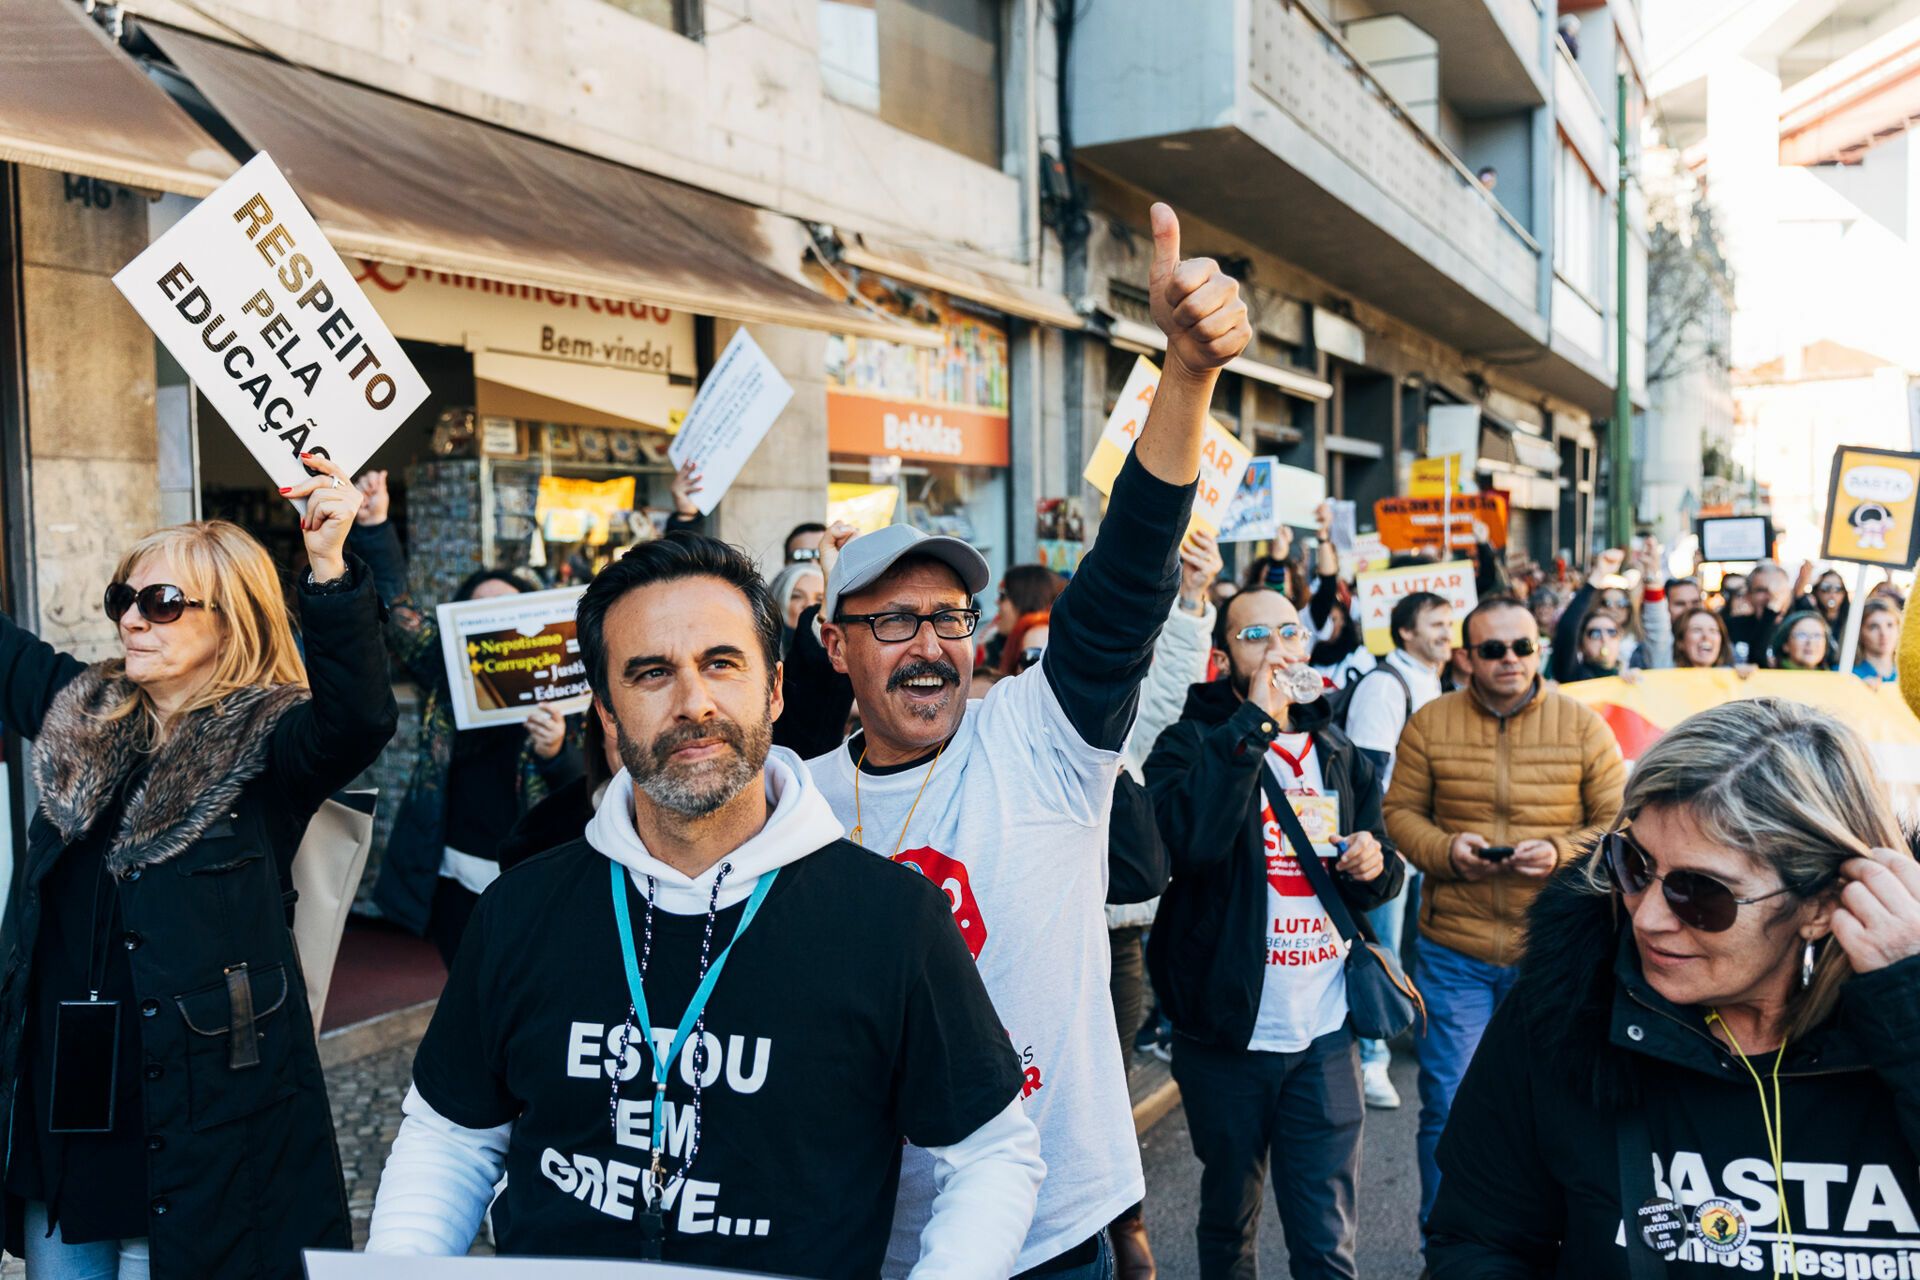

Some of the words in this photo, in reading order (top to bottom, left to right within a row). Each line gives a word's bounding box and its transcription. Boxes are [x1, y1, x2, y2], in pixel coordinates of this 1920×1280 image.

[232, 192, 397, 411] RESPEITO
[241, 288, 323, 397] PELA
[540, 324, 672, 370] Bem-vindo!
[156, 262, 331, 477] EDUCAÇÃO
[883, 412, 963, 456] Bebidas
[1371, 583, 1384, 597] A
[1391, 575, 1462, 596] LUTAR
[567, 1021, 772, 1094] ESTOU
[616, 1098, 697, 1159] EM
[541, 1147, 770, 1236] GREVE...
[1643, 1220, 1681, 1234] DOCENTES
[1651, 1213, 1669, 1224] NÃO
[1658, 1233, 1671, 1241] em
[1656, 1239, 1676, 1250] LUTA
